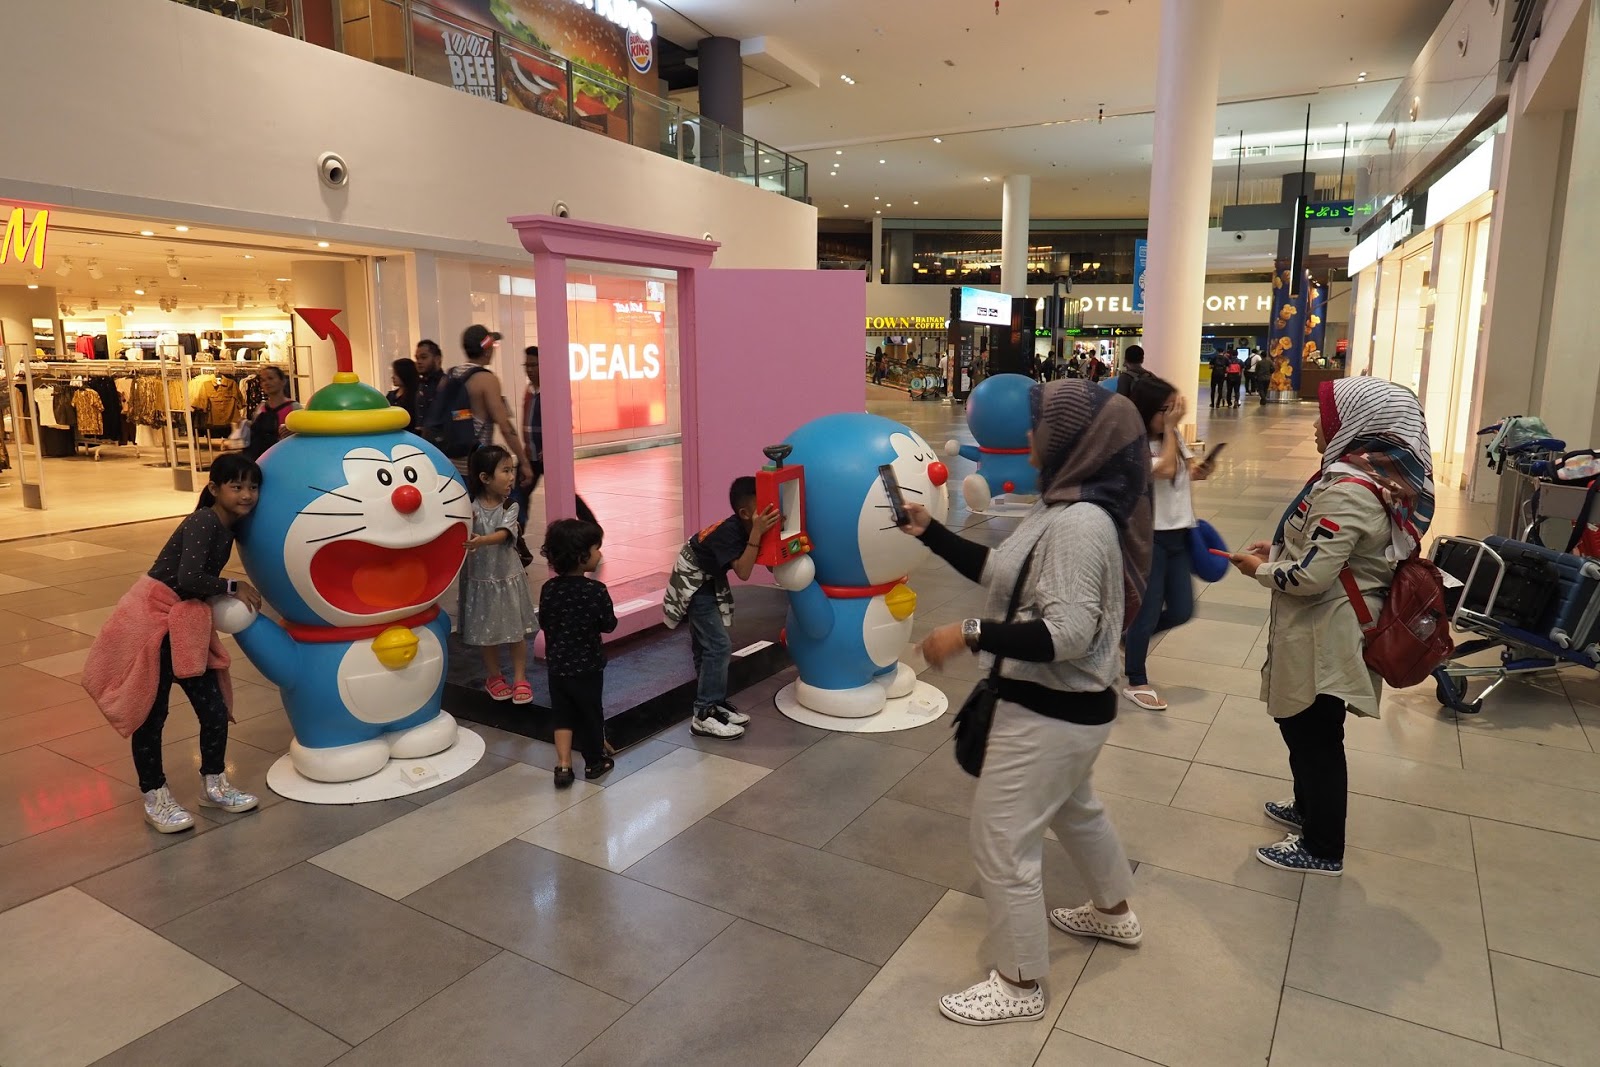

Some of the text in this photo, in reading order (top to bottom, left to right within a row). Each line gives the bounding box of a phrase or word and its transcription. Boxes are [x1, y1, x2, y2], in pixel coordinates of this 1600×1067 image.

[631, 44, 650, 56] KING
[448, 55, 496, 86] BEEF
[568, 343, 660, 381] DEALS
